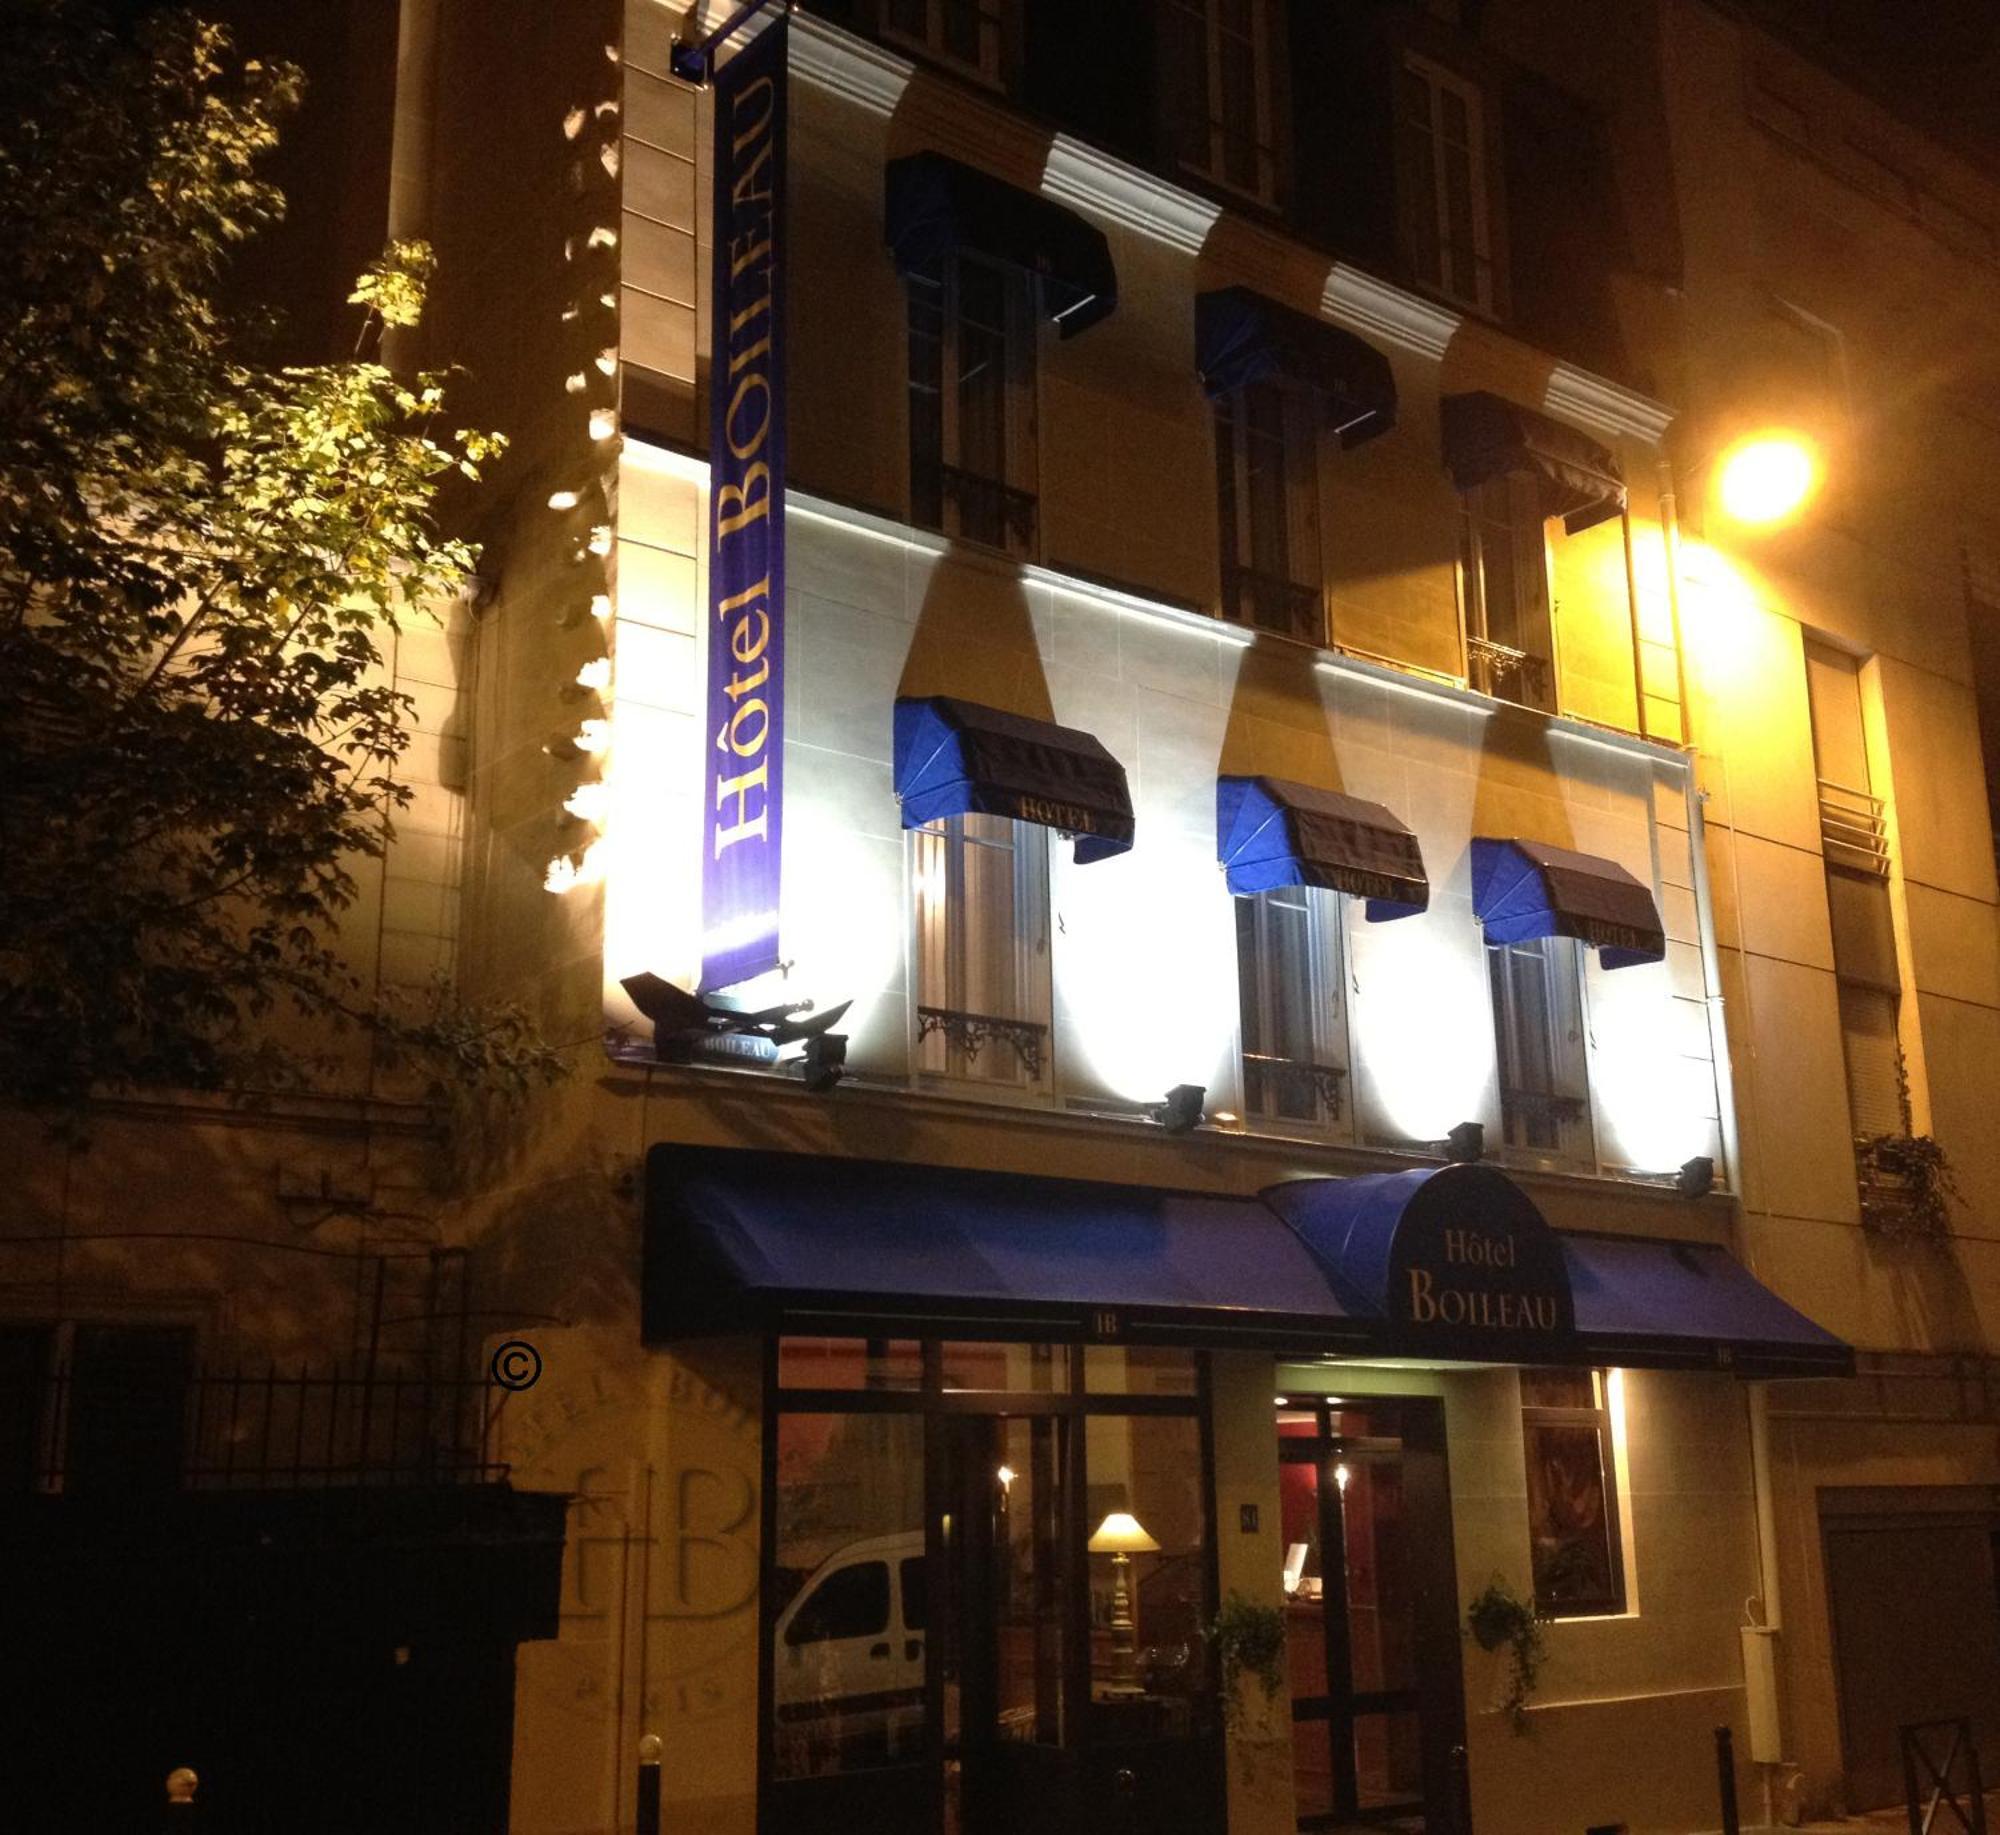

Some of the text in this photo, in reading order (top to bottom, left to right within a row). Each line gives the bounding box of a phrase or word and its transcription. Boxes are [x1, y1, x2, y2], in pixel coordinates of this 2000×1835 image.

[714, 76, 775, 860] Hôtel BOILEAU
[704, 1037, 771, 1058] BOILEAU
[1444, 1229, 1516, 1267] Hôtel
[1406, 1268, 1557, 1330] BOILEAU
